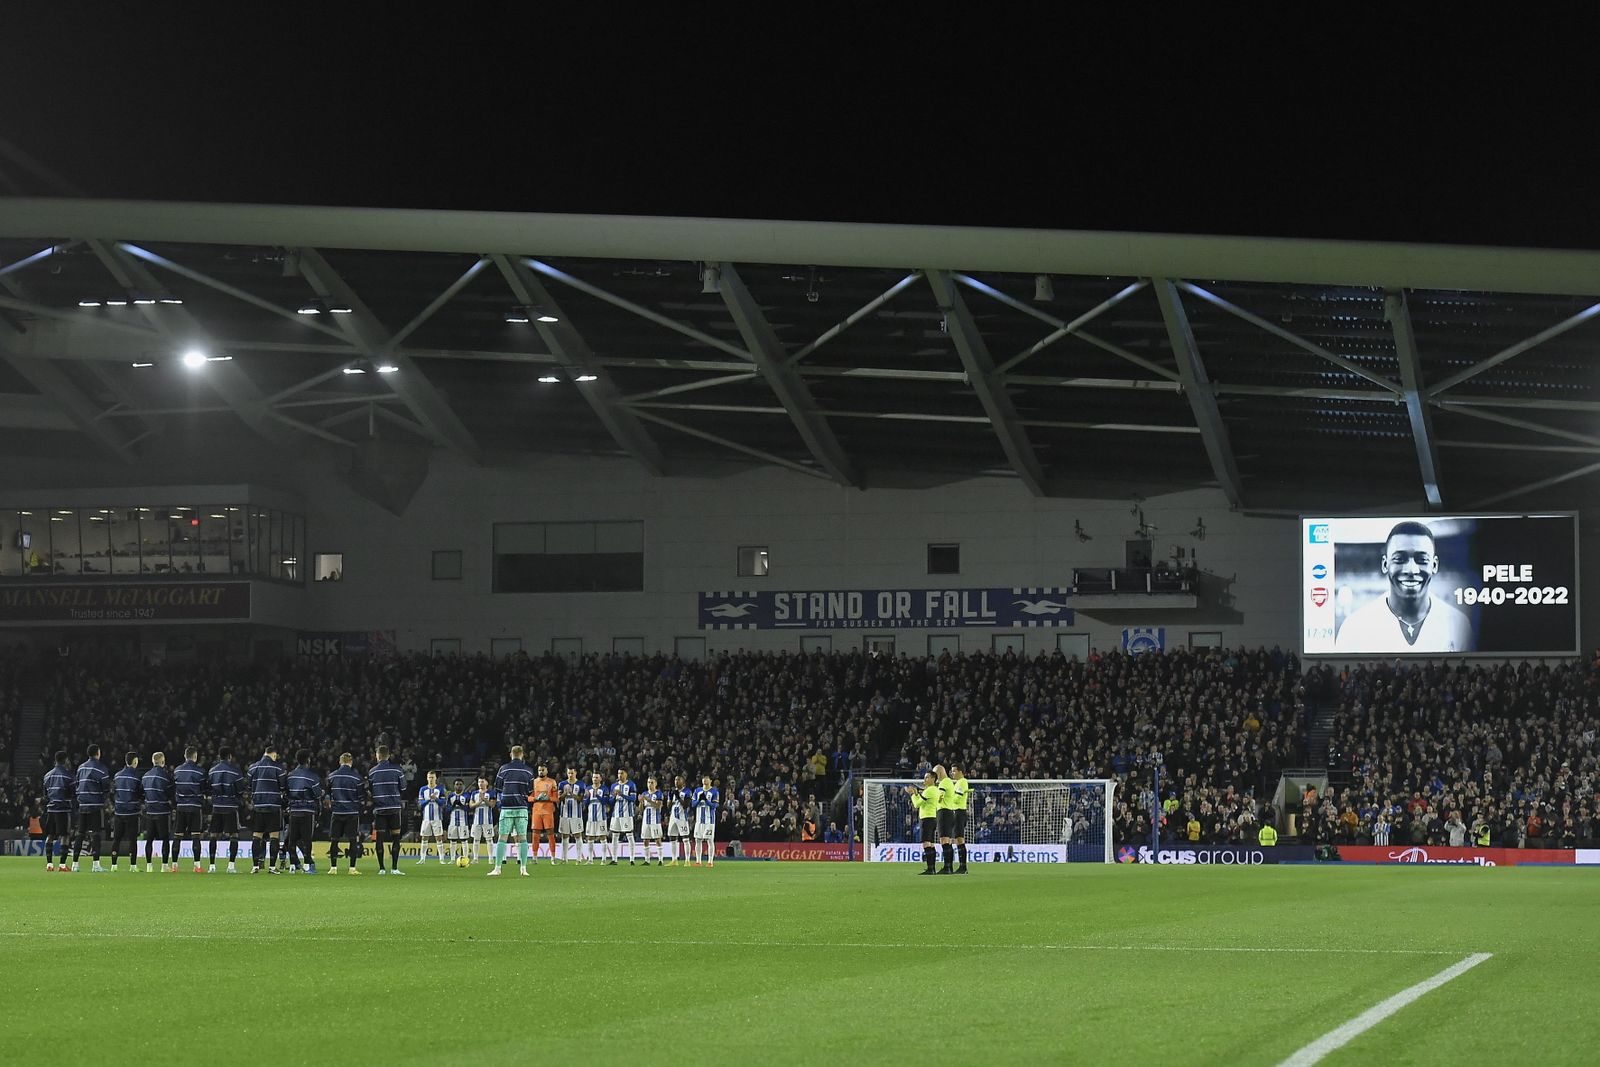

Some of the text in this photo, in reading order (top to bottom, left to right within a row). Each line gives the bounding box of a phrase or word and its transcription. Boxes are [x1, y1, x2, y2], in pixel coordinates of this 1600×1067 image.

[1483, 565, 1533, 582] PELE
[1, 590, 97, 606] MANSELL
[1454, 587, 1568, 605] 1940-2022
[70, 608, 156, 619] Trusted since 1947
[774, 591, 997, 620] STAND OR FALL
[816, 619, 956, 628] FOR SUSSEX BY THE SEA
[298, 639, 339, 655] NSK
